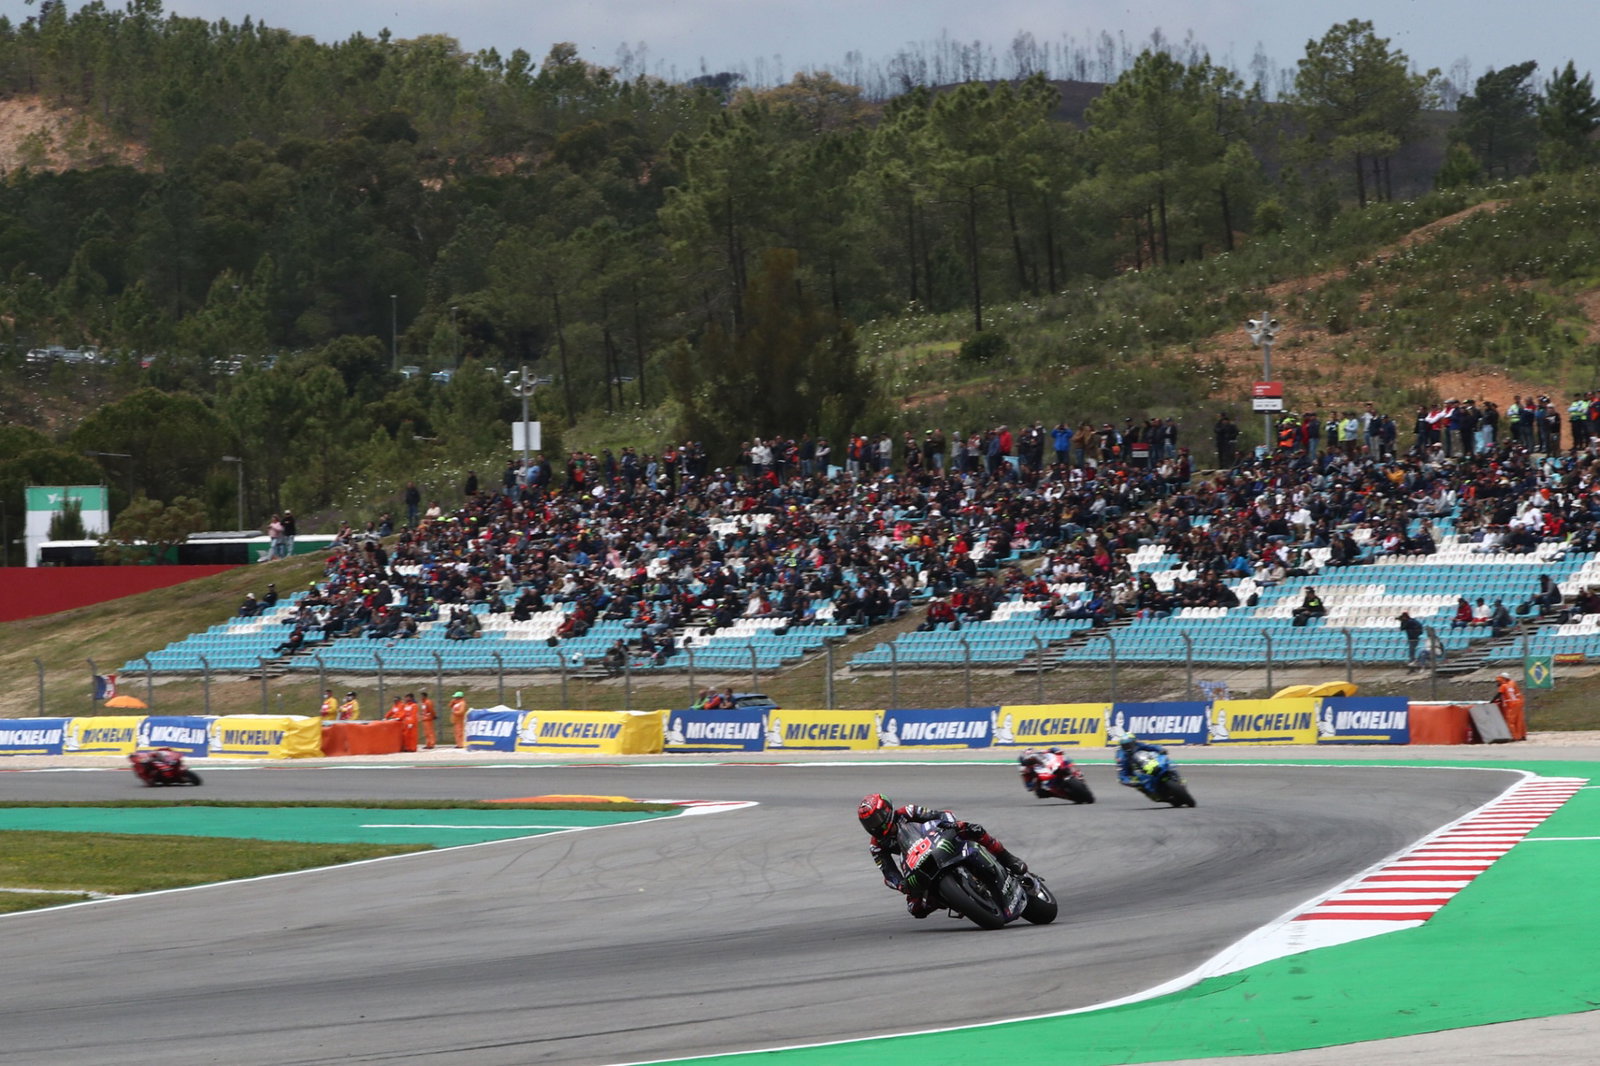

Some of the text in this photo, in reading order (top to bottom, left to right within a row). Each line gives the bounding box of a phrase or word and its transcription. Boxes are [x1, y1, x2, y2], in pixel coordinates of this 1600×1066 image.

[1017, 718, 1100, 735] MICHELIN
[1128, 715, 1204, 734] MICHELIN
[1230, 712, 1312, 731] MICHELIN
[1335, 711, 1407, 730] MICHELIN
[0, 729, 62, 745] MICHELIN
[224, 730, 285, 745] MICHELIN
[540, 722, 623, 739] MICHELIN
[686, 722, 761, 740] MICHELIN
[785, 723, 870, 740] MICHELIN
[901, 721, 988, 740] MICHELIN
